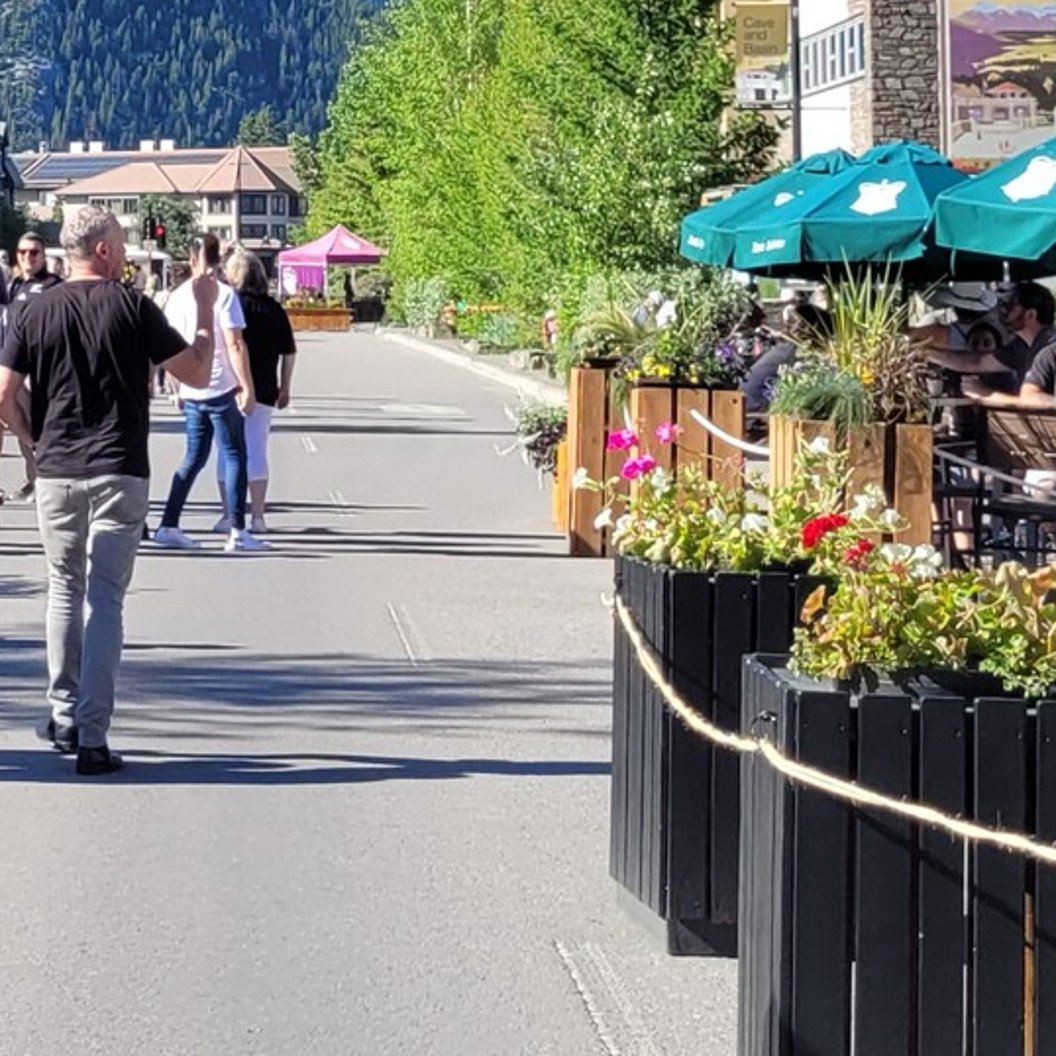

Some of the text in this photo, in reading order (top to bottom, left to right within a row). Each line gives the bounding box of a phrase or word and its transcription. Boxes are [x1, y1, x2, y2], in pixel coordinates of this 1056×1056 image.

[743, 17, 775, 29] Cave
[743, 30, 768, 41] and
[743, 43, 778, 55] Basin
